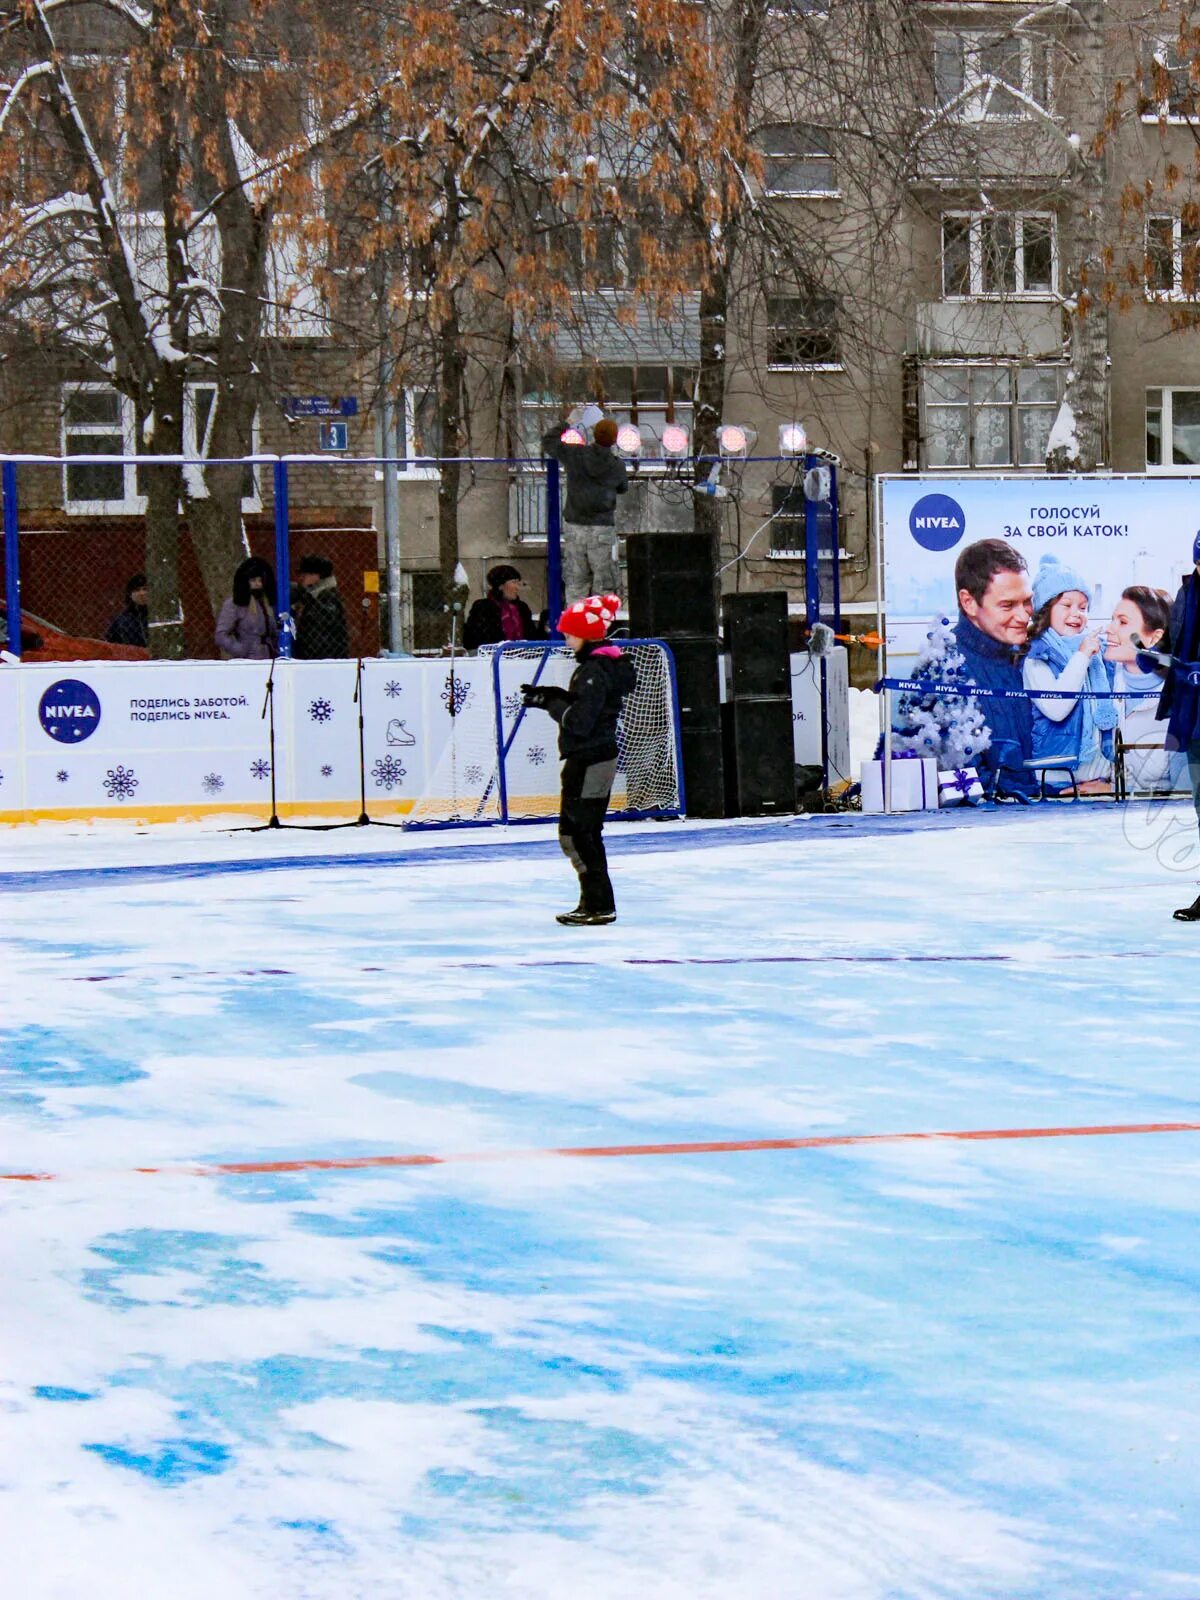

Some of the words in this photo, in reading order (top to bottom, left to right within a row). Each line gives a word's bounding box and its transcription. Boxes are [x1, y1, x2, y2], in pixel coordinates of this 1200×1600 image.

[330, 426, 337, 446] 3
[1030, 504, 1100, 519] ГОЛОСУЙ
[915, 516, 960, 529] NIVEA
[1003, 525, 1022, 537] ЗА
[1027, 522, 1068, 537] СВОЙ
[1074, 524, 1129, 537] КАТОК!
[898, 681, 922, 690] NIVEA
[935, 685, 958, 693] NIVEA
[970, 688, 993, 696] NIVEA
[1005, 690, 1028, 698] NIVEA
[130, 698, 190, 709] ПОДЕЛИСЬ
[194, 695, 250, 707] ЗАБОТОЙ.
[45, 704, 95, 718] NIVEA
[130, 711, 190, 722] ПОДЕЛИСЬ
[194, 711, 231, 720] NIVEA.
